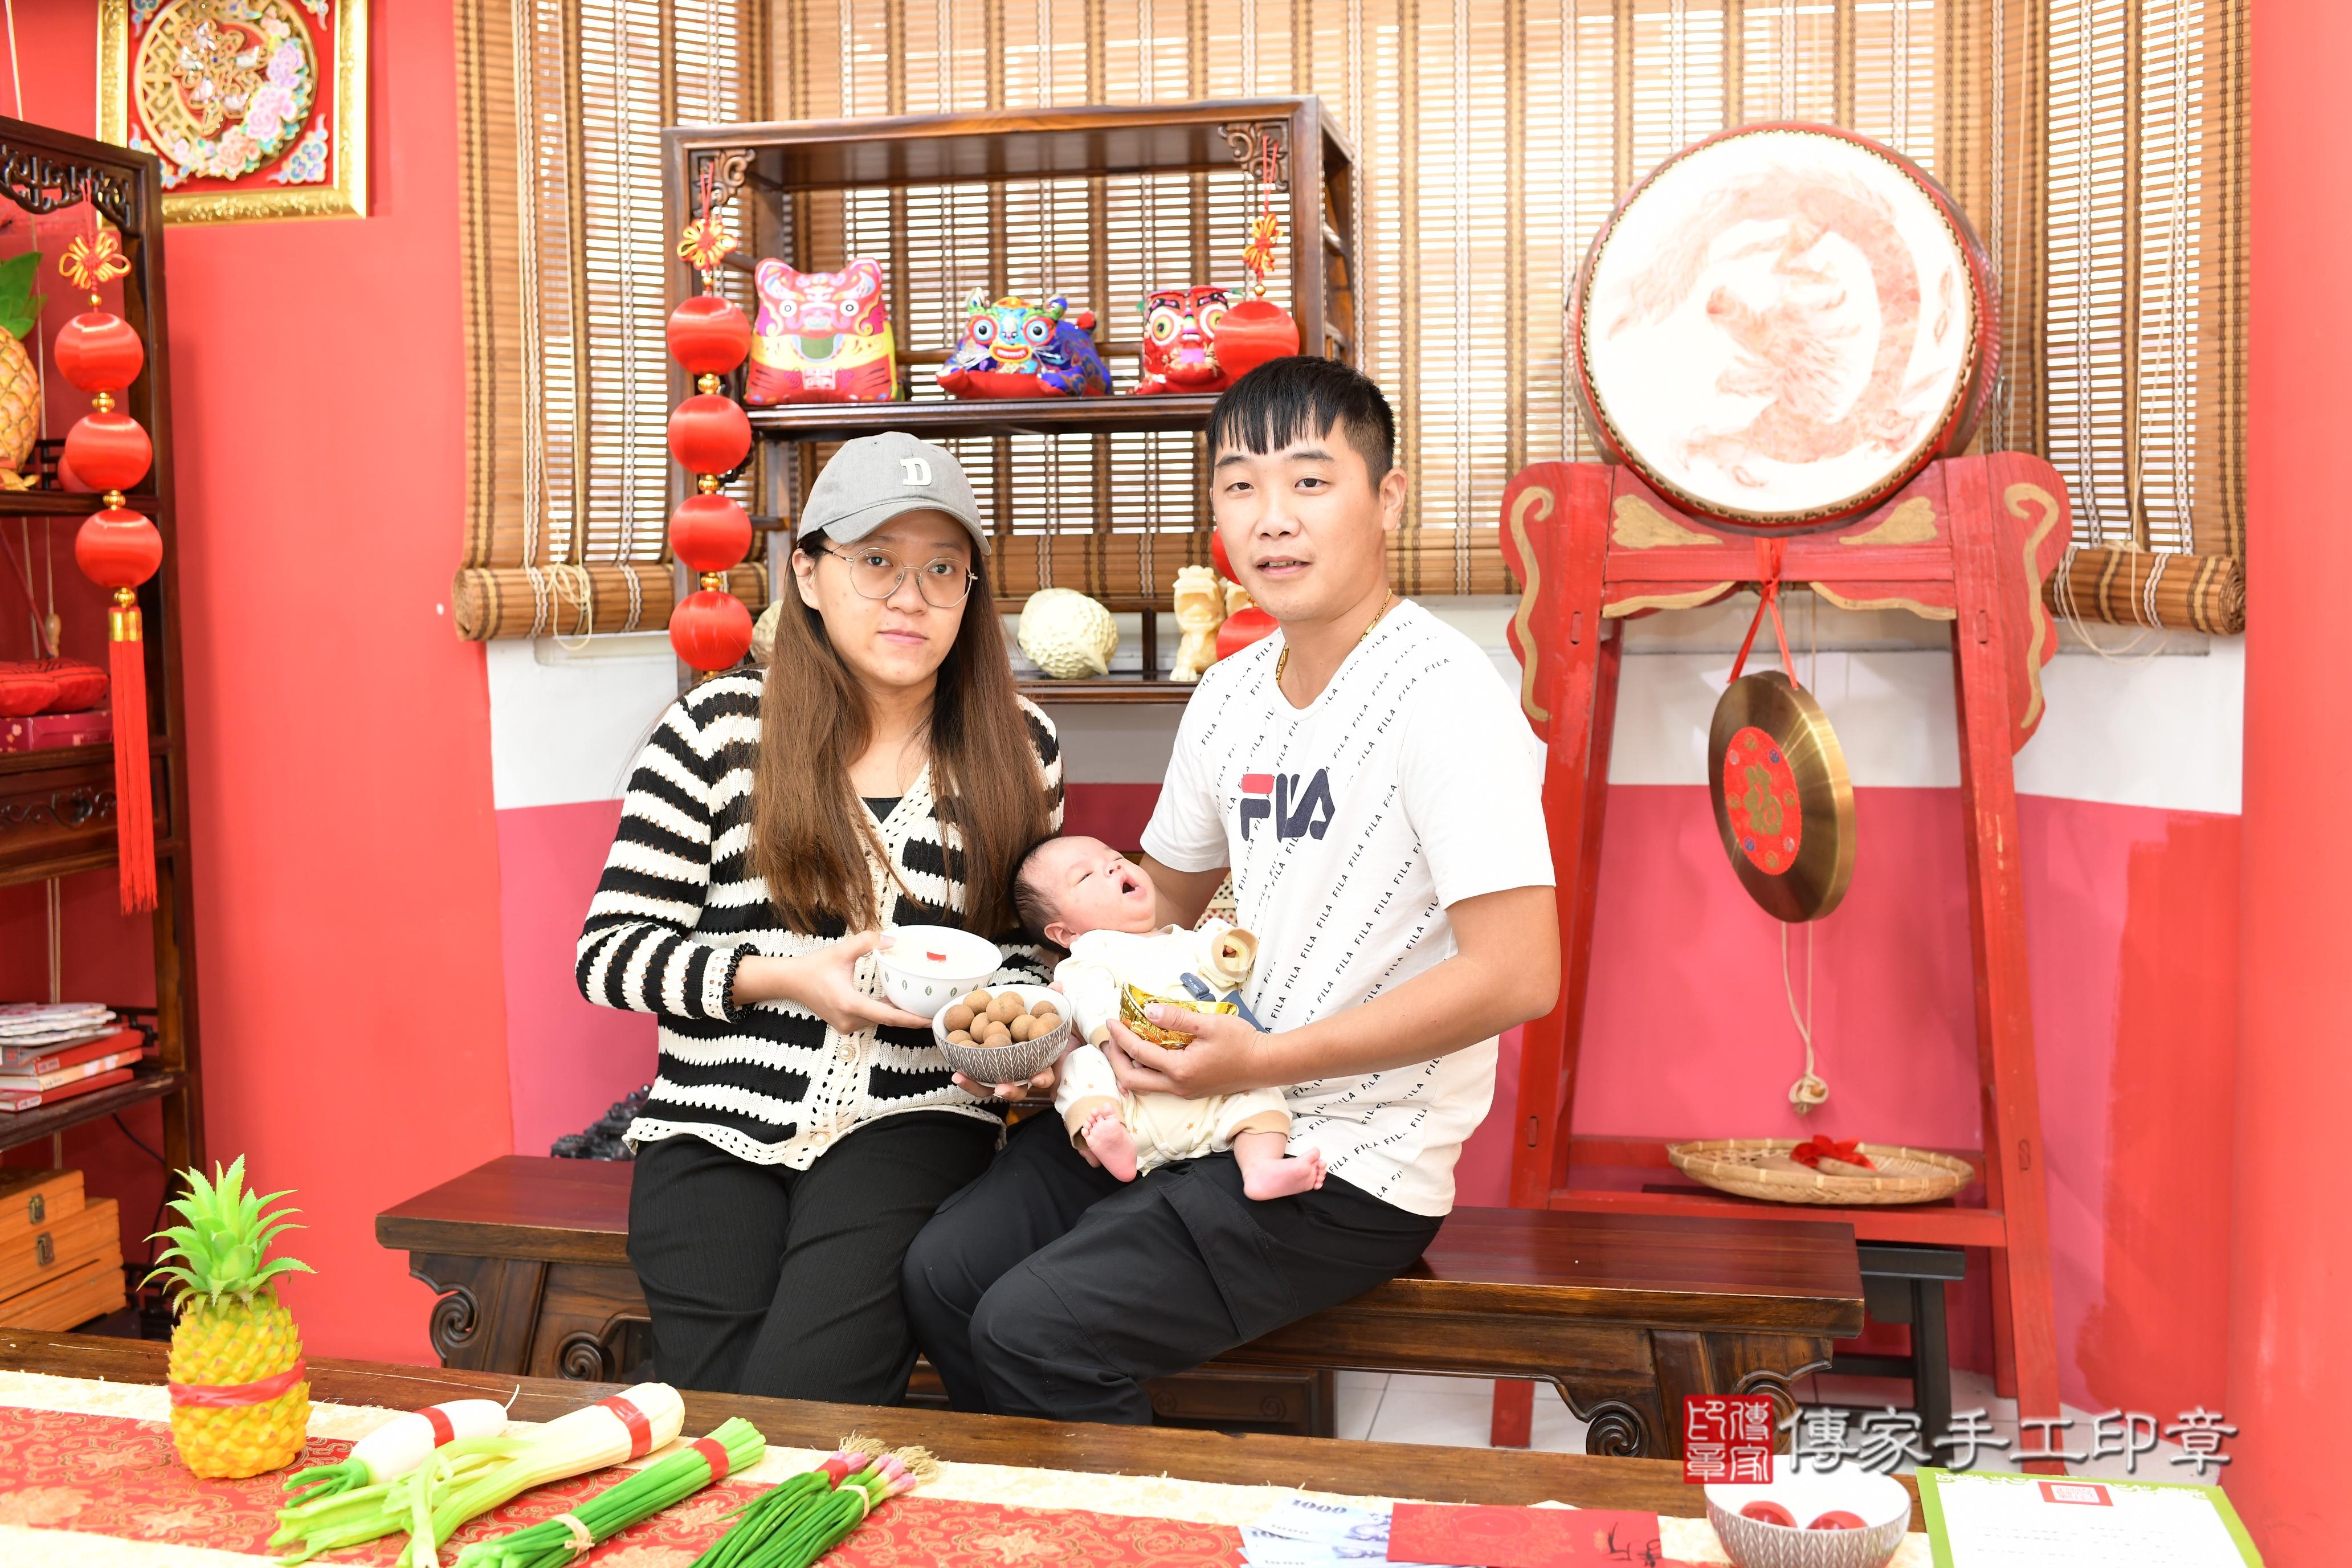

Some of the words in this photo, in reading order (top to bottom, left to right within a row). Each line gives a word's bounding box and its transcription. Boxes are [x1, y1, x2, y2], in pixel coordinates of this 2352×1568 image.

[899, 457, 932, 486] D
[1202, 724, 1216, 745] FILA
[1256, 642, 1273, 661] FILA
[1358, 742, 1374, 765] FILA
[1378, 709, 1395, 733] FILA
[1399, 678, 1416, 701] FILA
[1425, 659, 1449, 672] FILA
[1217, 766, 1226, 787] FILA
[1239, 868, 1247, 890] FILA
[1276, 745, 1288, 767] FILA
[1240, 769, 1335, 843] FILA
[1272, 862, 1285, 887] FILA
[1334, 736, 1349, 758] FILA
[1353, 705, 1367, 728] FILA
[1373, 673, 1388, 696] FILA
[1271, 997, 1286, 1019] FILA
[1285, 967, 1301, 989] FILA
[1301, 936, 1317, 958] FILA
[1317, 905, 1332, 928] FILA
[1333, 875, 1348, 897] FILA
[1349, 844, 1363, 867] FILA
[1365, 815, 1382, 837] FILA
[1383, 785, 1397, 807] FILA
[1317, 982, 1333, 1003] FILA
[1336, 952, 1353, 974] FILA
[1354, 922, 1373, 945] FILA
[1374, 892, 1393, 914] FILA
[1394, 861, 1412, 884] FILA
[1385, 957, 1403, 976] FILA
[1406, 927, 1424, 949] FILA
[1329, 1156, 1349, 1173] FILA
[1354, 1142, 1379, 1154] FILA
[1411, 1109, 1427, 1127] FILA
[1292, 1499, 1347, 1514] 1000
